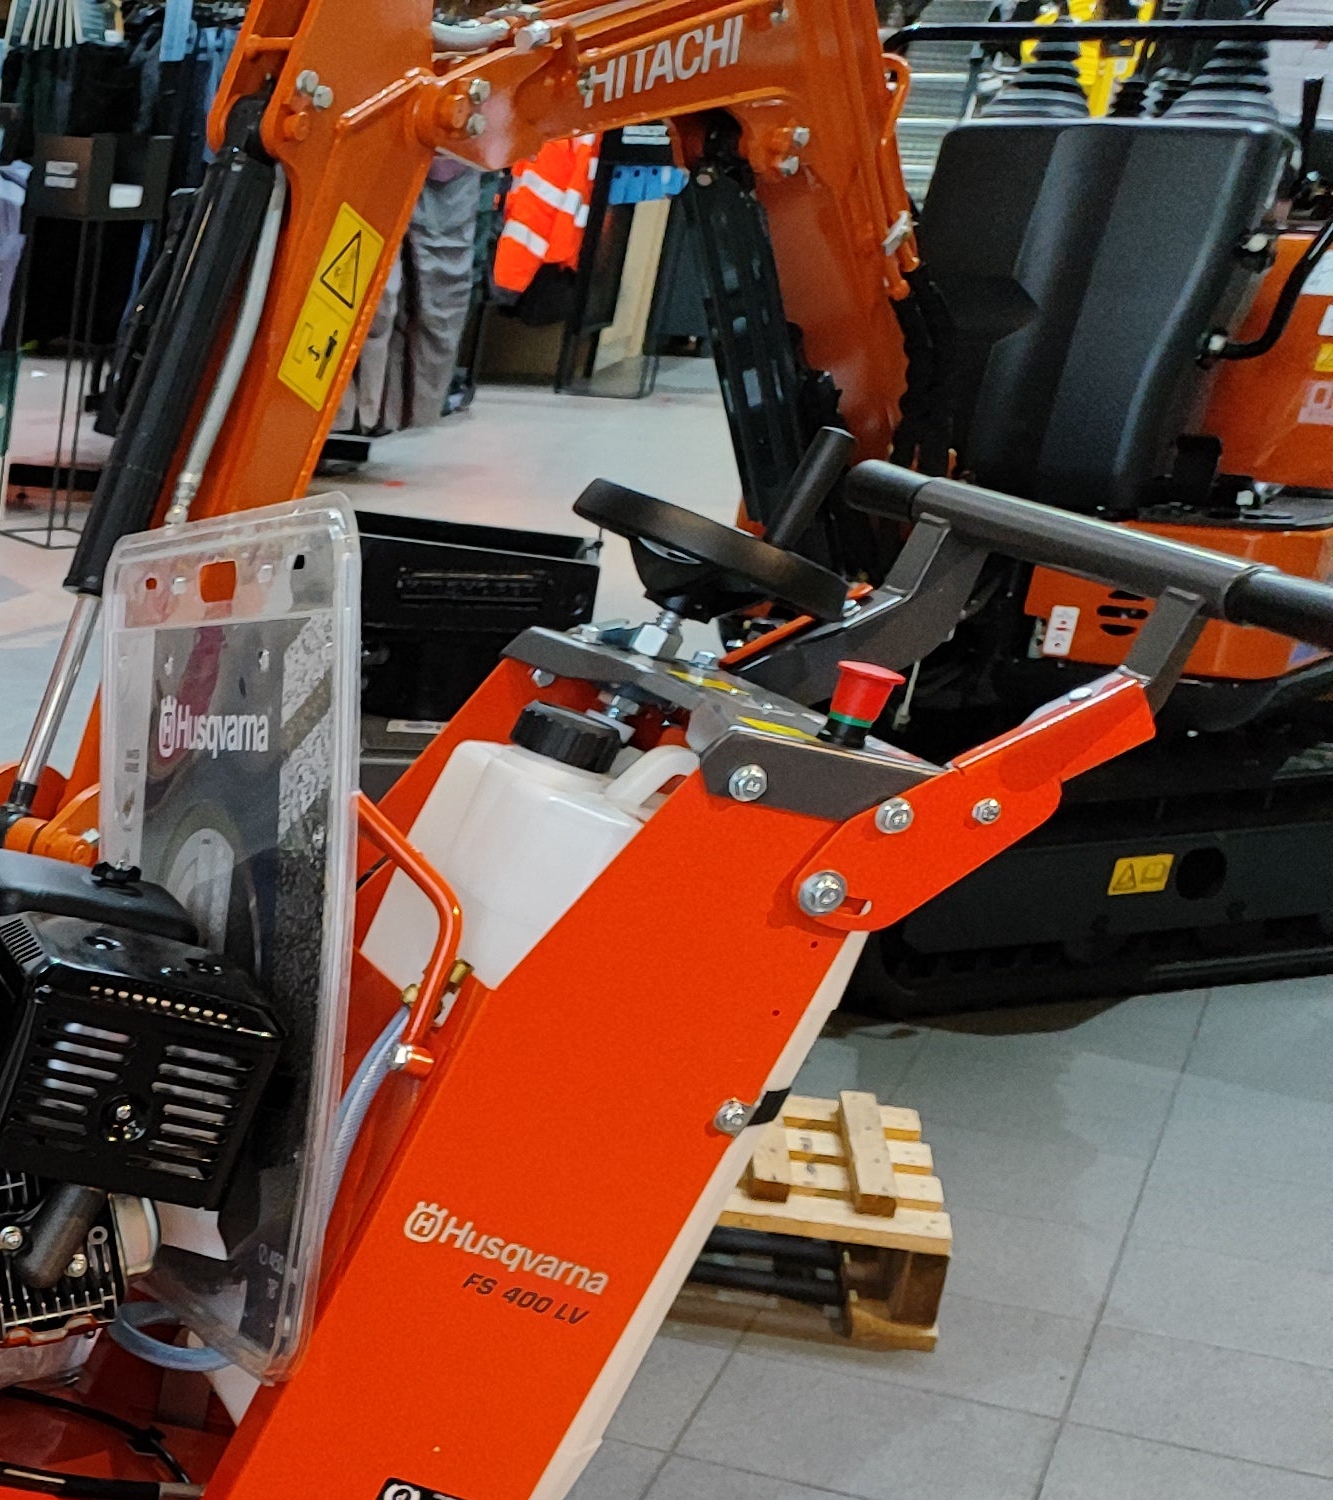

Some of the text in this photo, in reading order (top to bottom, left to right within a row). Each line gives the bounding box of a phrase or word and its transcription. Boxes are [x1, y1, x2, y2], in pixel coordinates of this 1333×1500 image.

[583, 14, 744, 108] HITACHI
[174, 704, 269, 759] Husqvarna
[438, 1216, 610, 1295] Husqvarna
[462, 1273, 590, 1325] FS 400 LV
